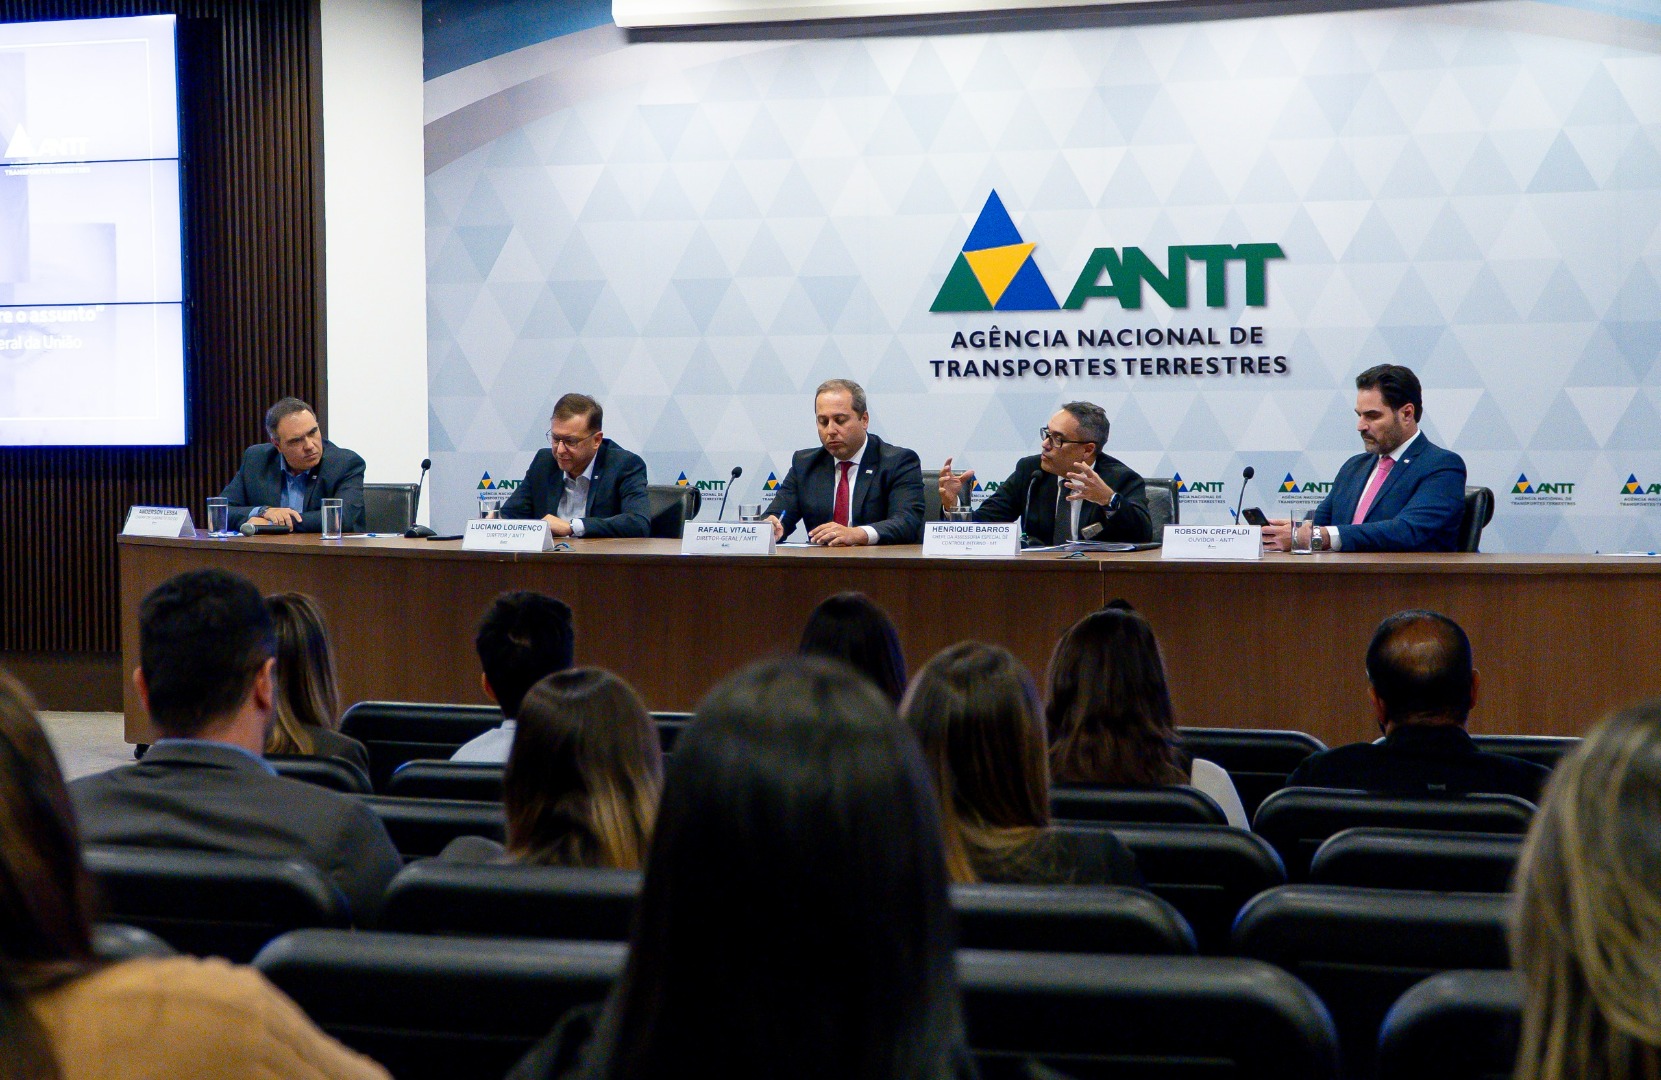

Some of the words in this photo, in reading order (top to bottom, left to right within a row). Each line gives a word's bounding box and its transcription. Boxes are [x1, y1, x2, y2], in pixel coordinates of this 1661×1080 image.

[1062, 243, 1286, 310] ANTT
[16, 311, 26, 322] o
[24, 336, 41, 349] da
[43, 335, 82, 349] União
[951, 325, 1069, 349] AGÊNCIA
[1077, 327, 1221, 347] NACIONAL
[1229, 327, 1264, 345] DE
[930, 358, 1117, 377] TRANSPORTES
[1122, 356, 1288, 375] TERRESTRES
[497, 480, 523, 489] ANT
[695, 480, 726, 491] ANTT
[1189, 482, 1225, 492] ANTT
[1536, 483, 1575, 494] ANTT
[471, 523, 502, 531] LUCIANO
[503, 524, 543, 532] LOURENÇO
[698, 526, 728, 534] RAFAEL
[932, 525, 974, 533] HENRIQUE
